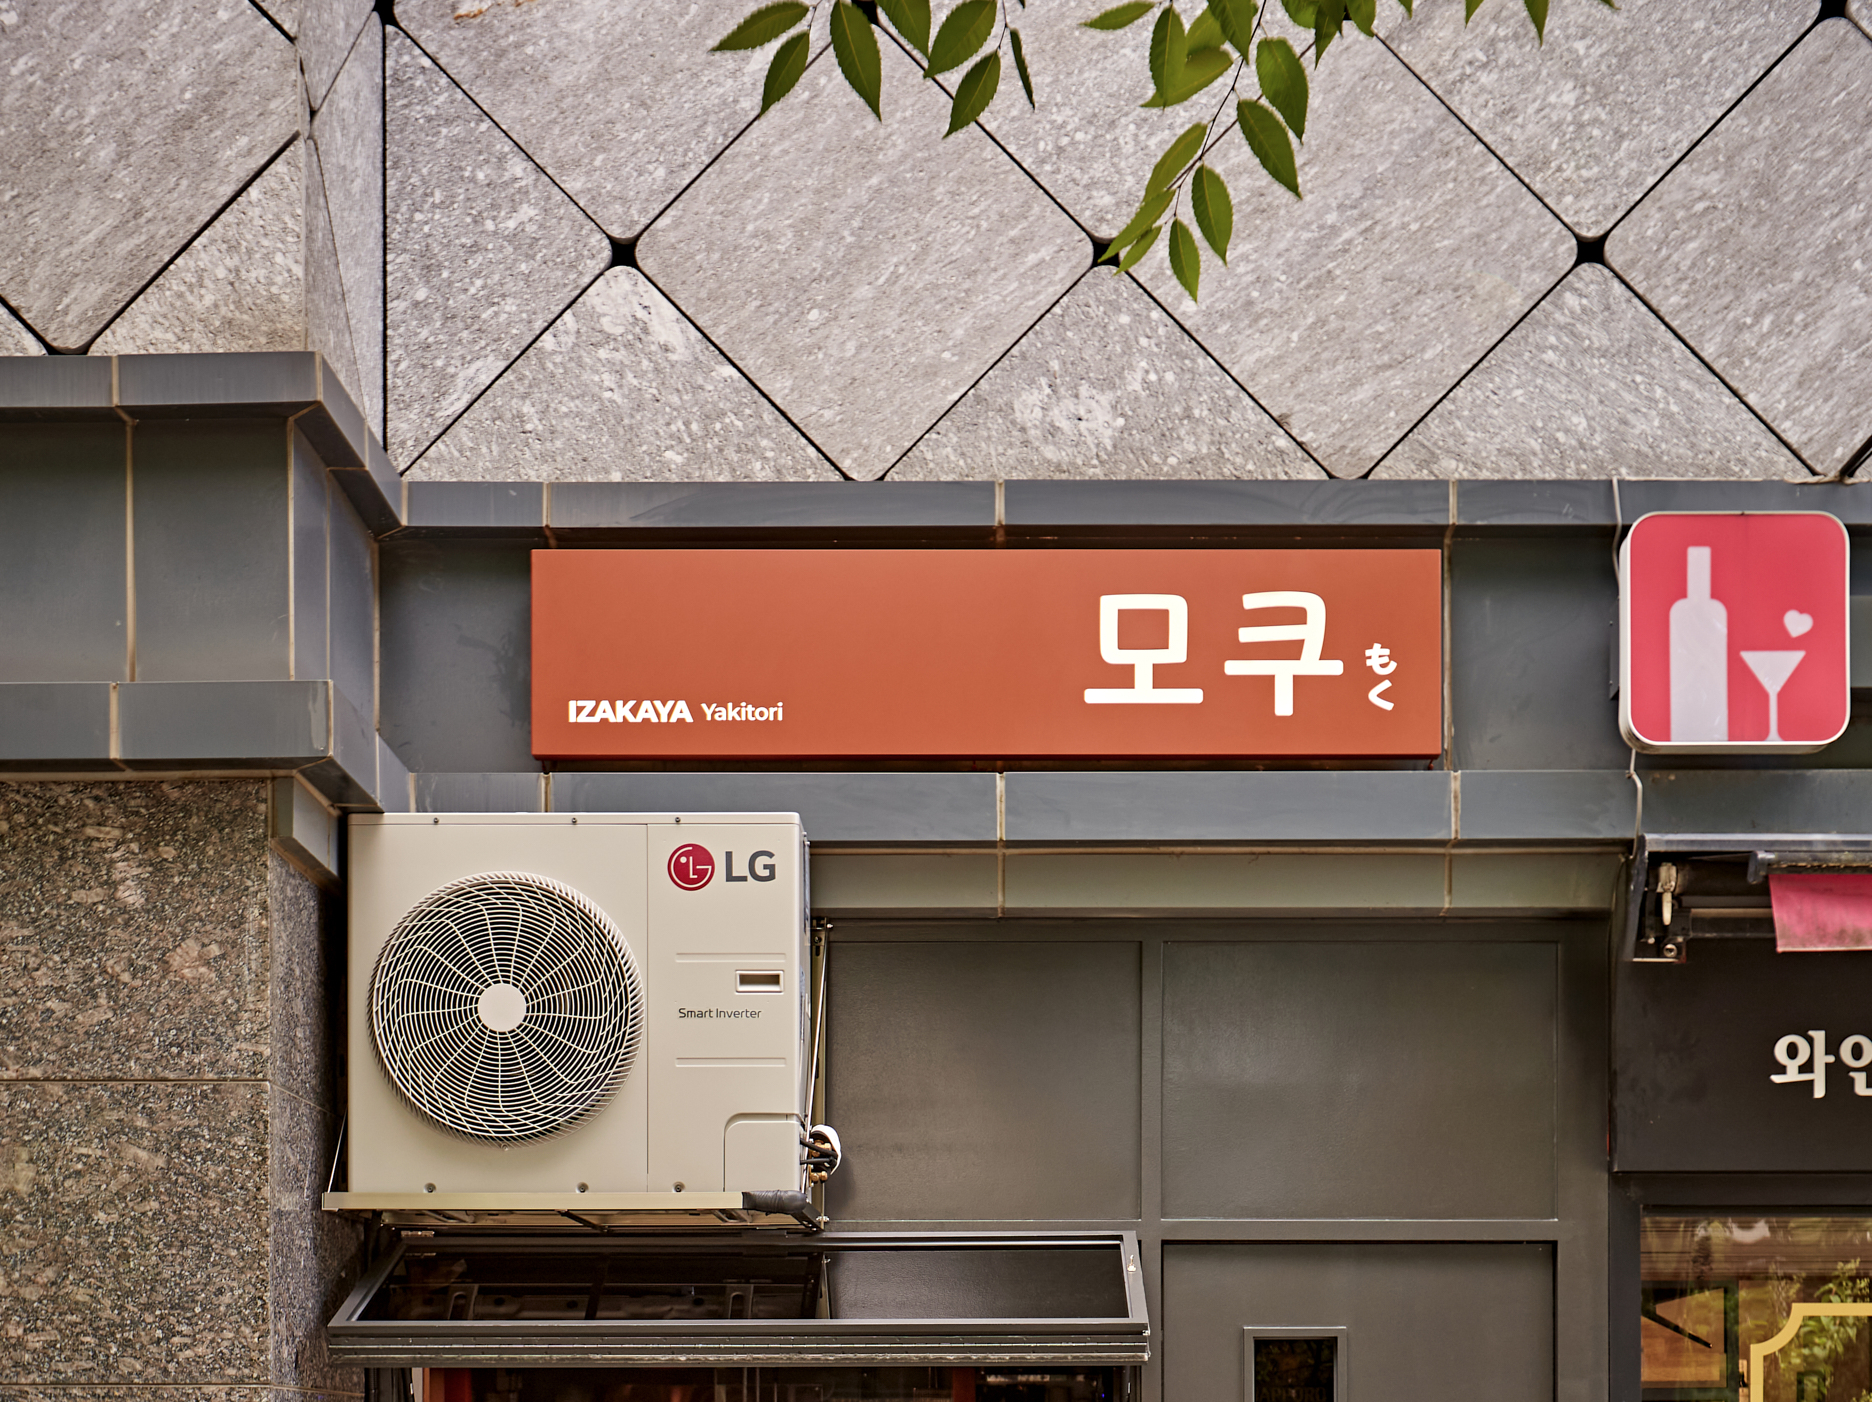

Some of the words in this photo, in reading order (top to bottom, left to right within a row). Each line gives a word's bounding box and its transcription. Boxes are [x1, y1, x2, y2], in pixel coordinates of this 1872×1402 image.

[1083, 590, 1344, 717] 모쿠
[1364, 642, 1398, 711] もく
[568, 699, 694, 723] IZAKAYA
[700, 701, 784, 722] Yakitori
[725, 850, 776, 883] LG
[678, 1006, 714, 1019] Smart
[715, 1006, 762, 1019] Inverter
